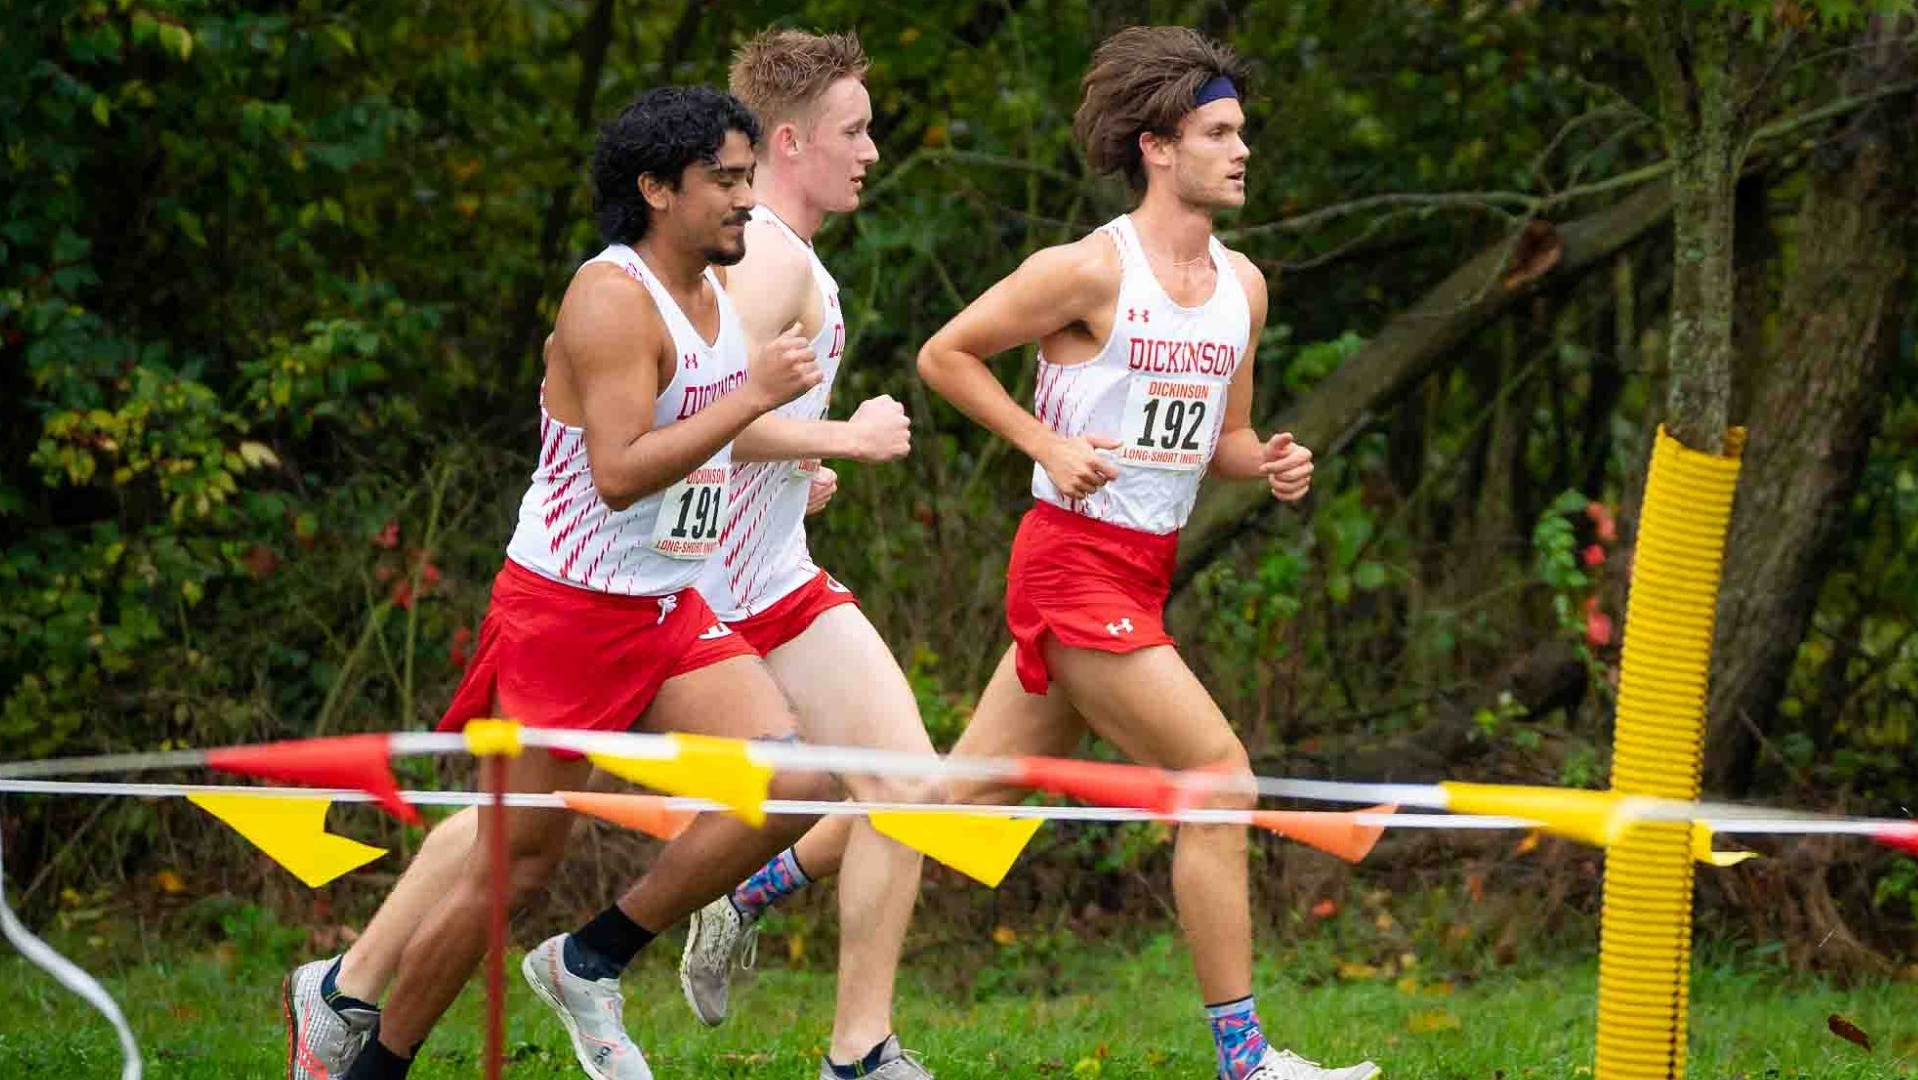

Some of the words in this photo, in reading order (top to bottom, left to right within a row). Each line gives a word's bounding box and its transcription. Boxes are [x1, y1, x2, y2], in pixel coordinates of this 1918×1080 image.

[1128, 338, 1239, 376] DICKINSON
[1149, 381, 1209, 398] DICKINSON
[1137, 399, 1206, 450] 192
[1123, 448, 1178, 463] LONG-SHORT
[671, 486, 721, 539] 191
[655, 540, 703, 554] LONG-SHORT
